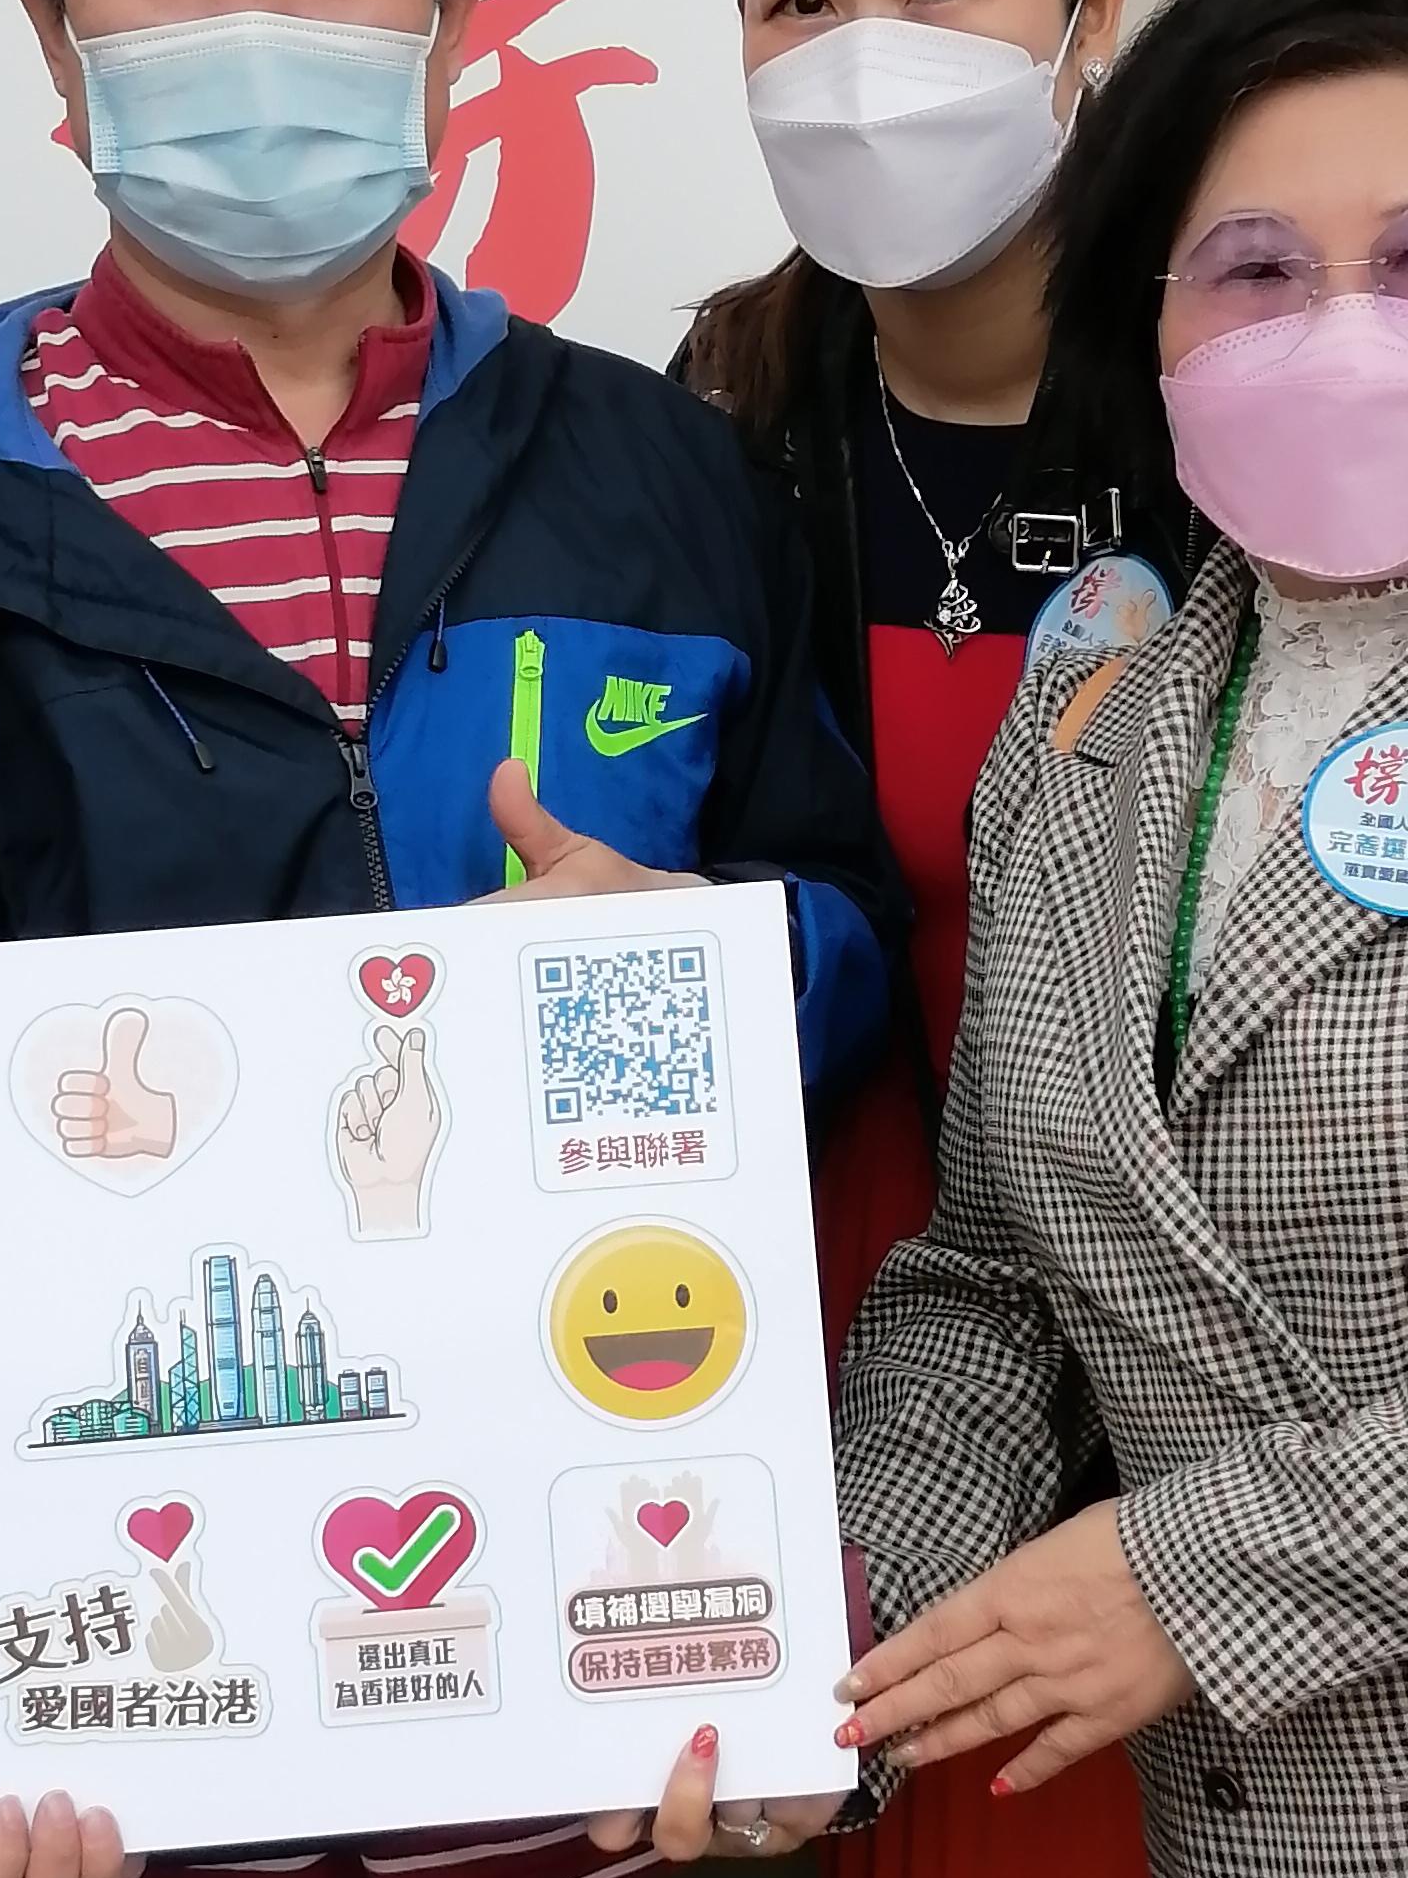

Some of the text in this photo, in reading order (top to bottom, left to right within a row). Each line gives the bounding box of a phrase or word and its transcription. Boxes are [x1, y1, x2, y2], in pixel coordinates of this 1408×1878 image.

[597, 675, 672, 723] NIKE
[558, 1129, 708, 1175] 參與聯署
[573, 1583, 767, 1629] 填補選舉漏洞
[358, 1636, 457, 1671] 選出真正
[578, 1637, 771, 1683] 保持香港繁榮
[22, 1678, 258, 1731] 愛國者治港
[335, 1670, 485, 1708] 為香港好的人
